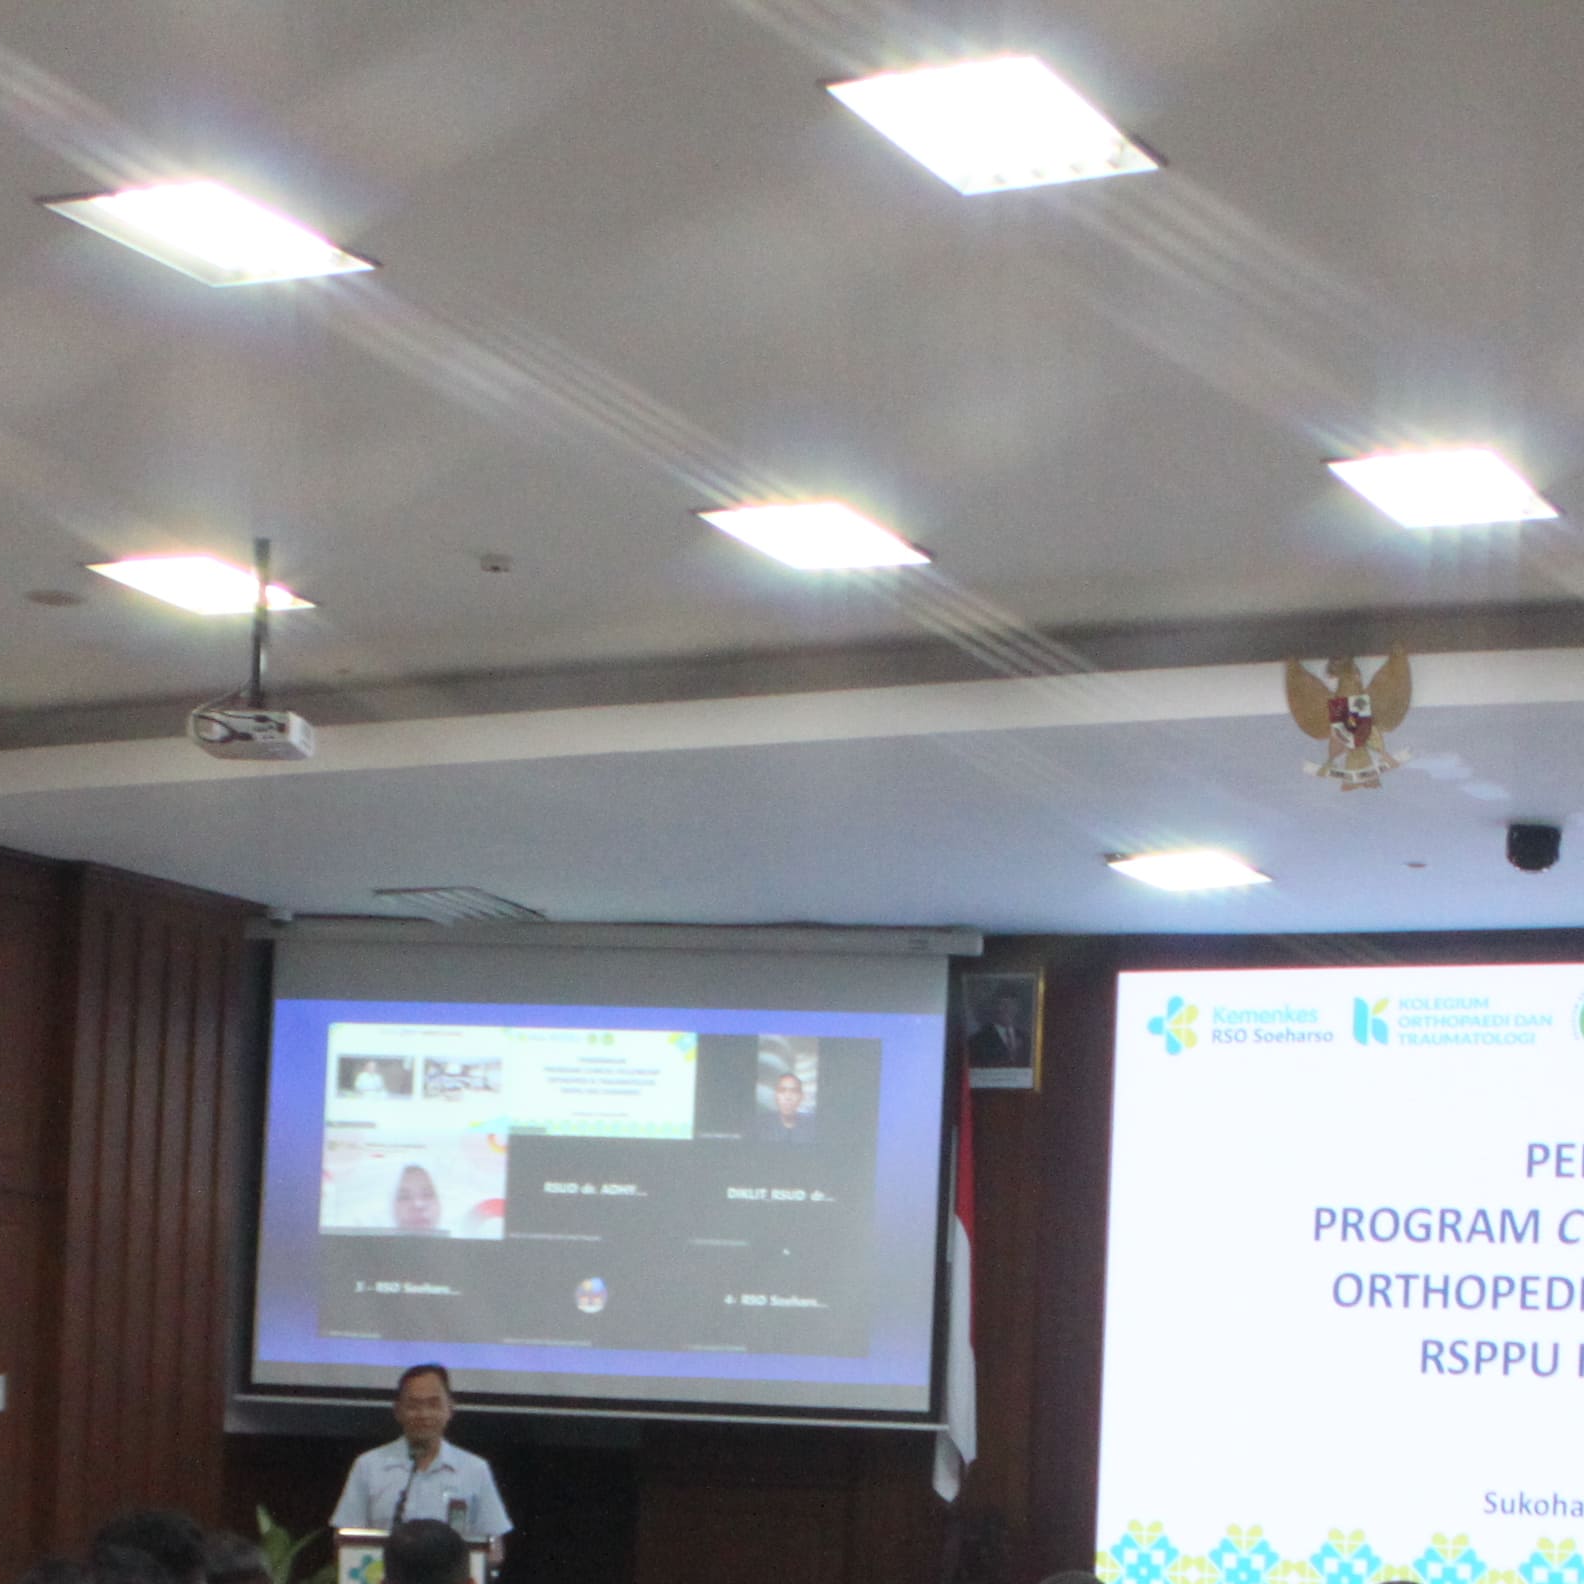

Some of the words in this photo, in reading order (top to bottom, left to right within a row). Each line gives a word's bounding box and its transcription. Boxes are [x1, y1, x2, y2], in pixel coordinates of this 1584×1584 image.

[1398, 997, 1490, 1012] KOLEGIUM
[1212, 1005, 1319, 1025] Kemenkes
[1397, 1014, 1510, 1029] ORTHOPAEDI
[1514, 1013, 1553, 1028] DAN
[1212, 1028, 1248, 1044] RSO
[1252, 1027, 1335, 1044] Soeharso
[1397, 1032, 1537, 1046] TRAUMATOLOGI
[1313, 1206, 1541, 1245] PROGRAM
[1420, 1338, 1560, 1379] RSPPU
